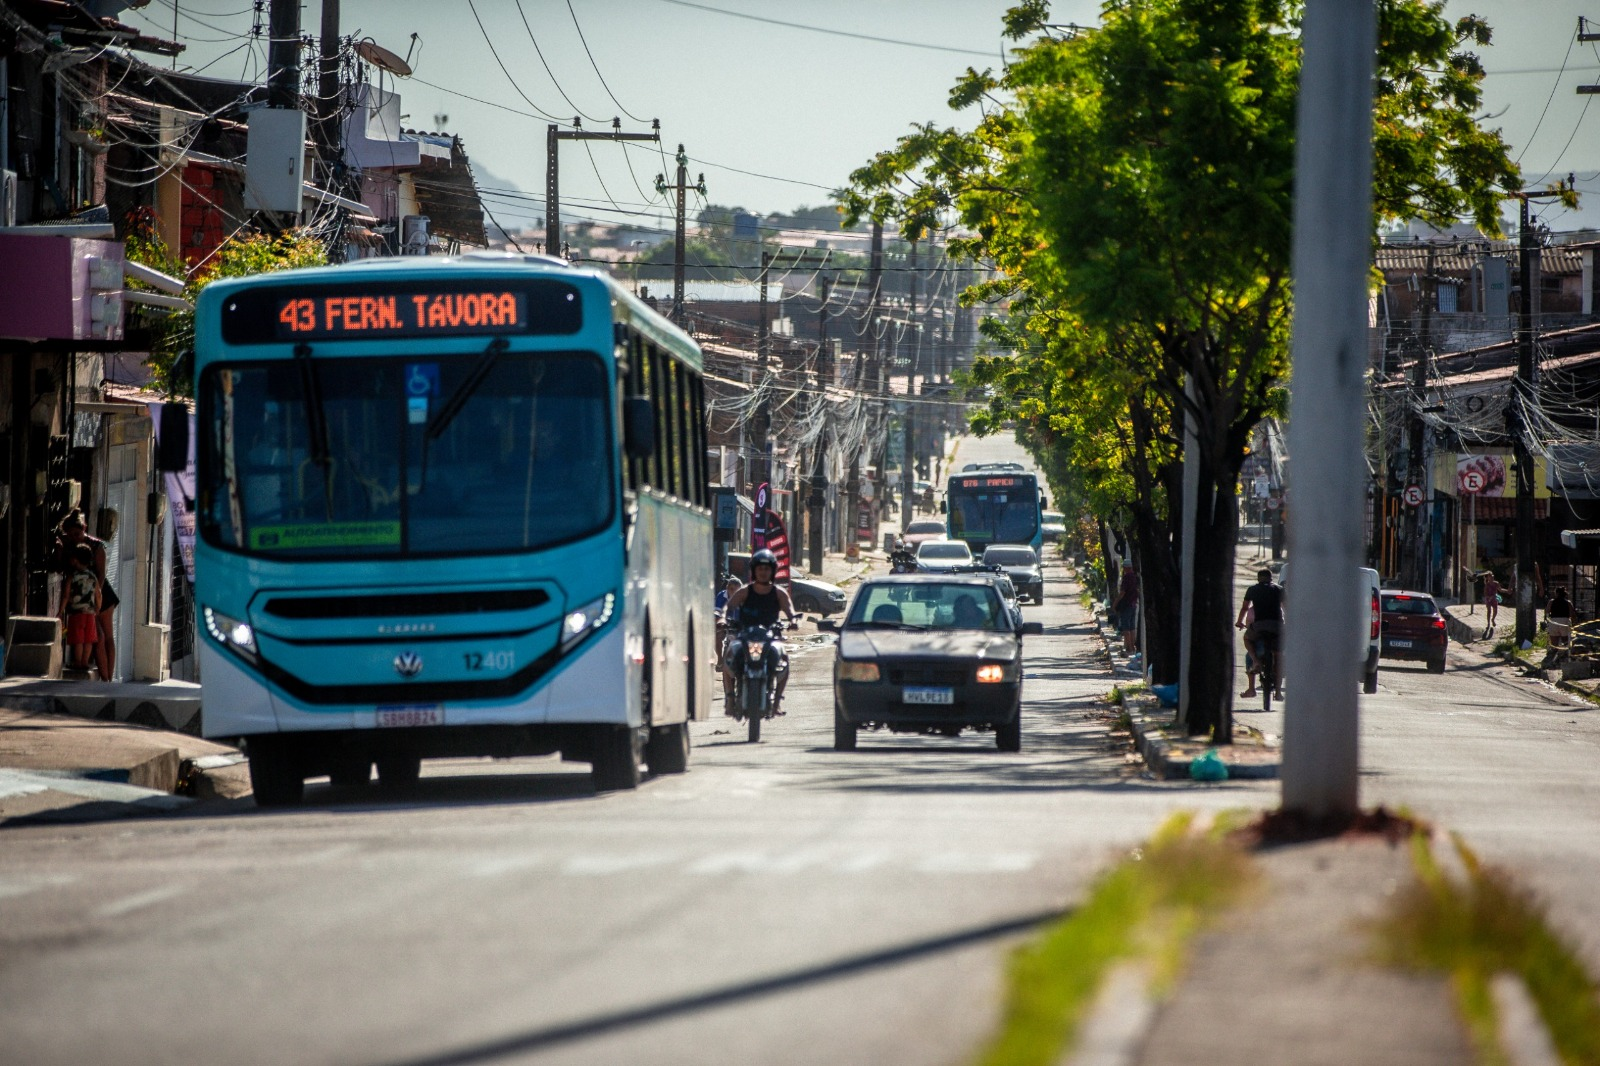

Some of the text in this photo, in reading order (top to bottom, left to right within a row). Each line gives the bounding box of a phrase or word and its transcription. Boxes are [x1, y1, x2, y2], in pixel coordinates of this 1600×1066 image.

[279, 291, 517, 332] 43 FERN. TÁVORA
[463, 650, 515, 671] 12401
